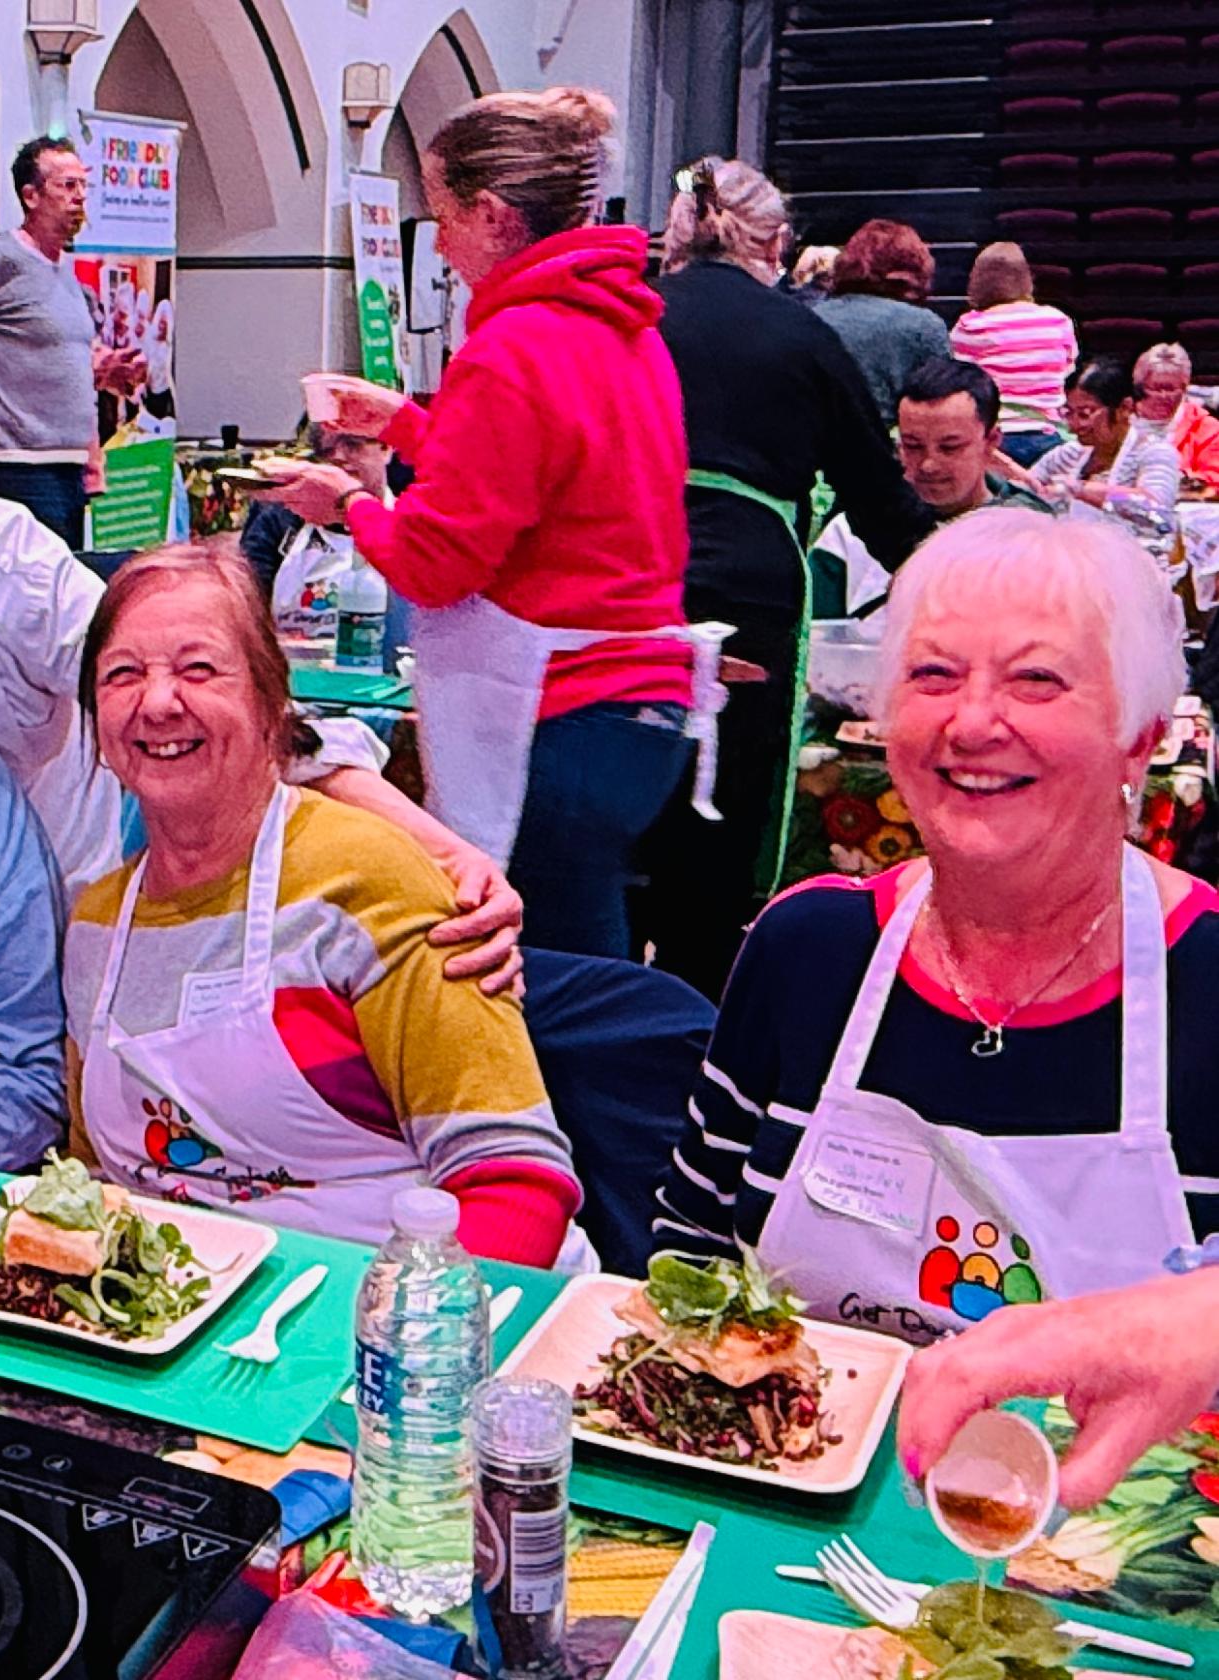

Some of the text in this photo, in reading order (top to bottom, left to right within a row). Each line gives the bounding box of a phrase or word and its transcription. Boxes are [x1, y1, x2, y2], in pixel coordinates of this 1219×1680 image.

[102, 164, 169, 192] FOOD CLUB
[839, 1292, 892, 1324] Get
